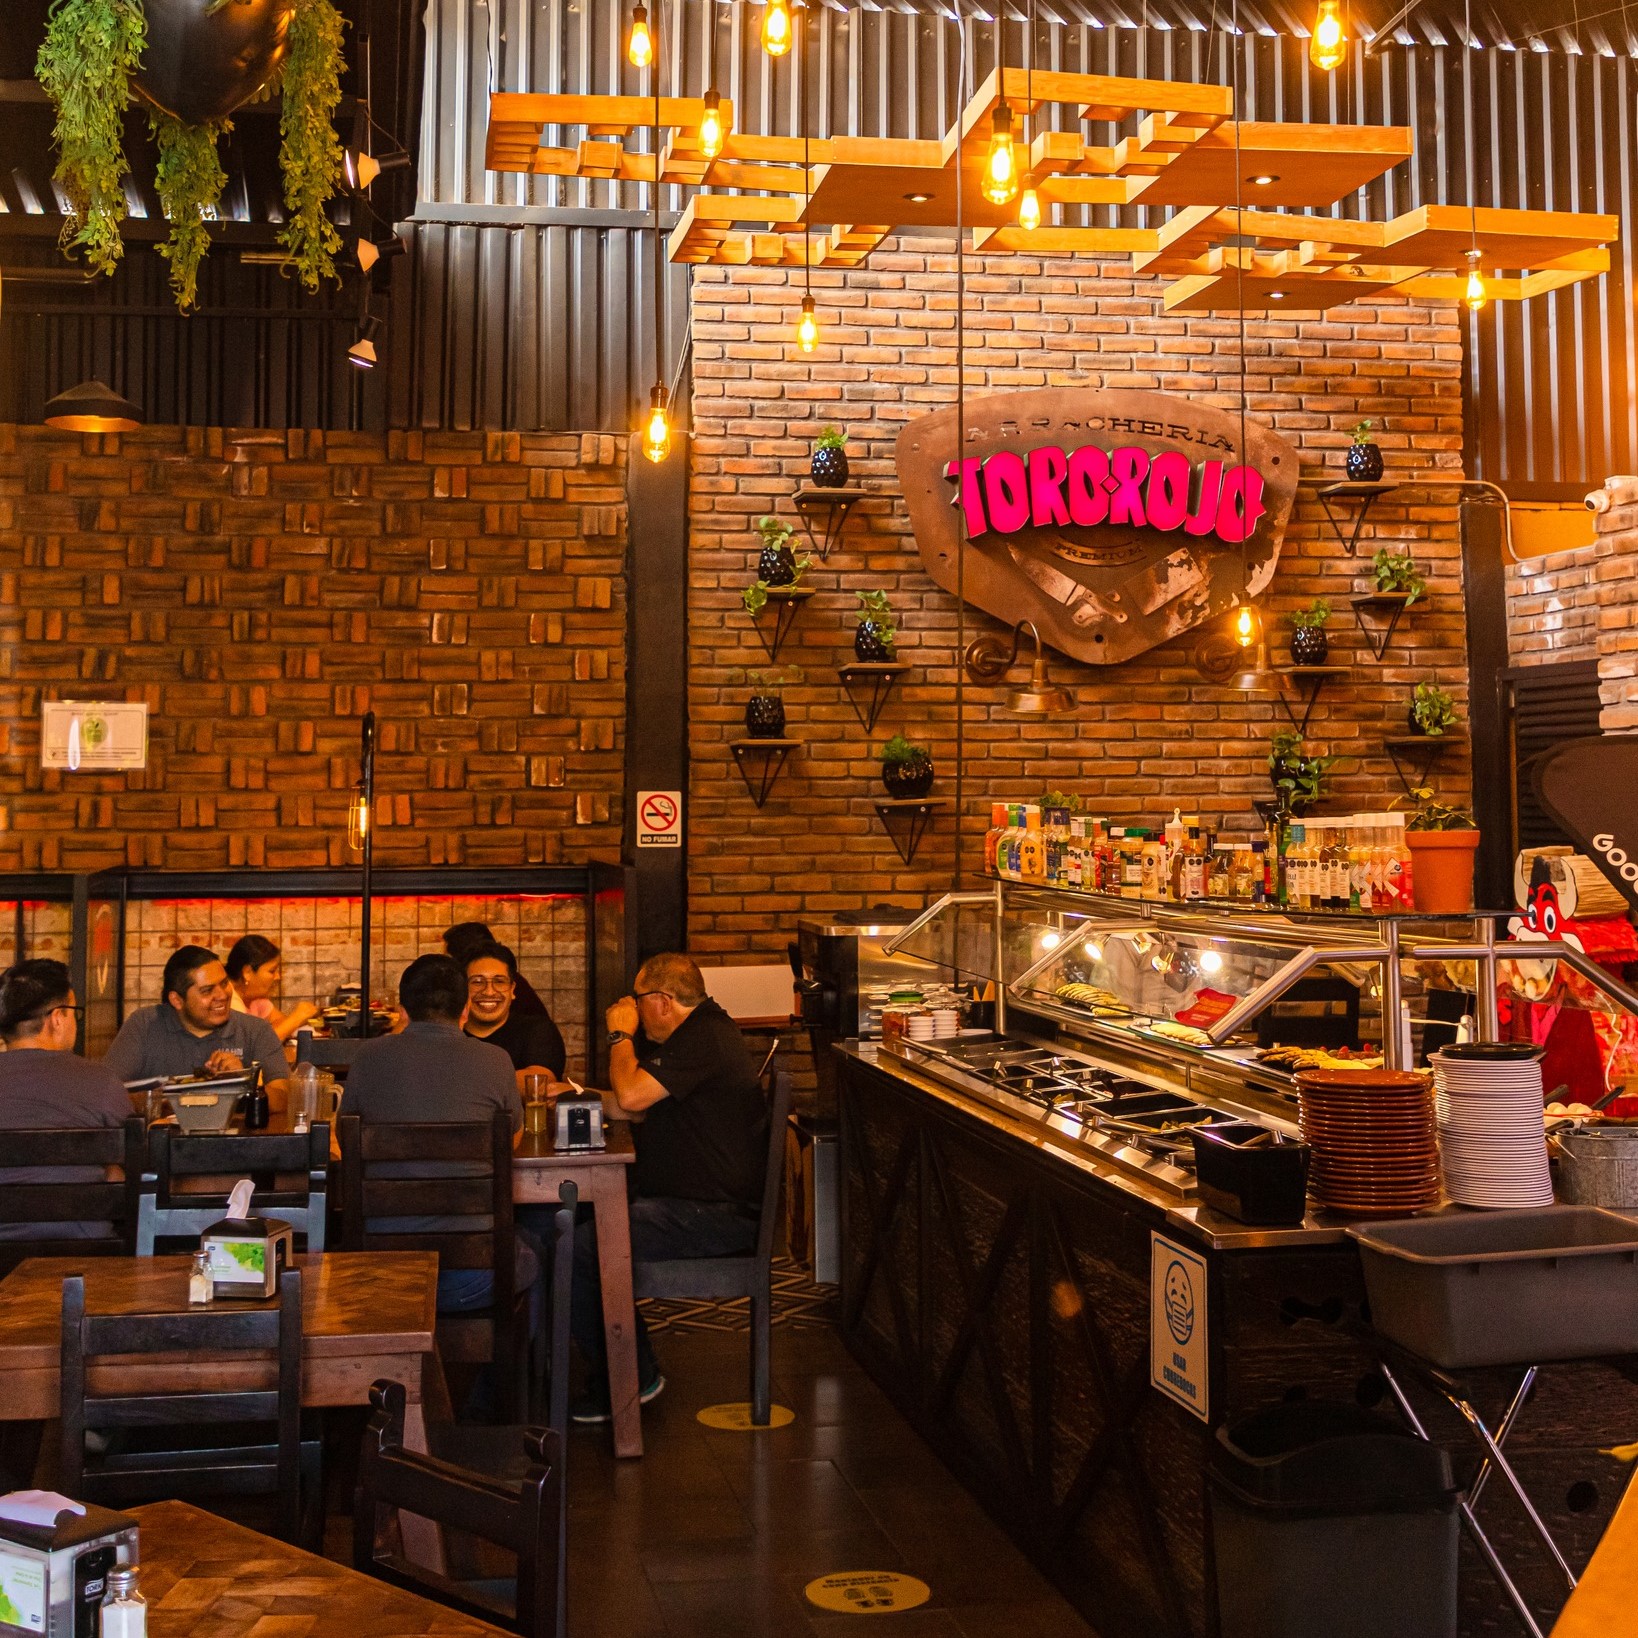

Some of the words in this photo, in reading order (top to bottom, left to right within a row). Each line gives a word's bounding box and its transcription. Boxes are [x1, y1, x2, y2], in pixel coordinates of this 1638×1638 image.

[1054, 543, 1144, 560] PREMIUM
[641, 835, 652, 843] NO
[653, 835, 677, 843] FUMAR
[1592, 833, 1638, 895] GOO
